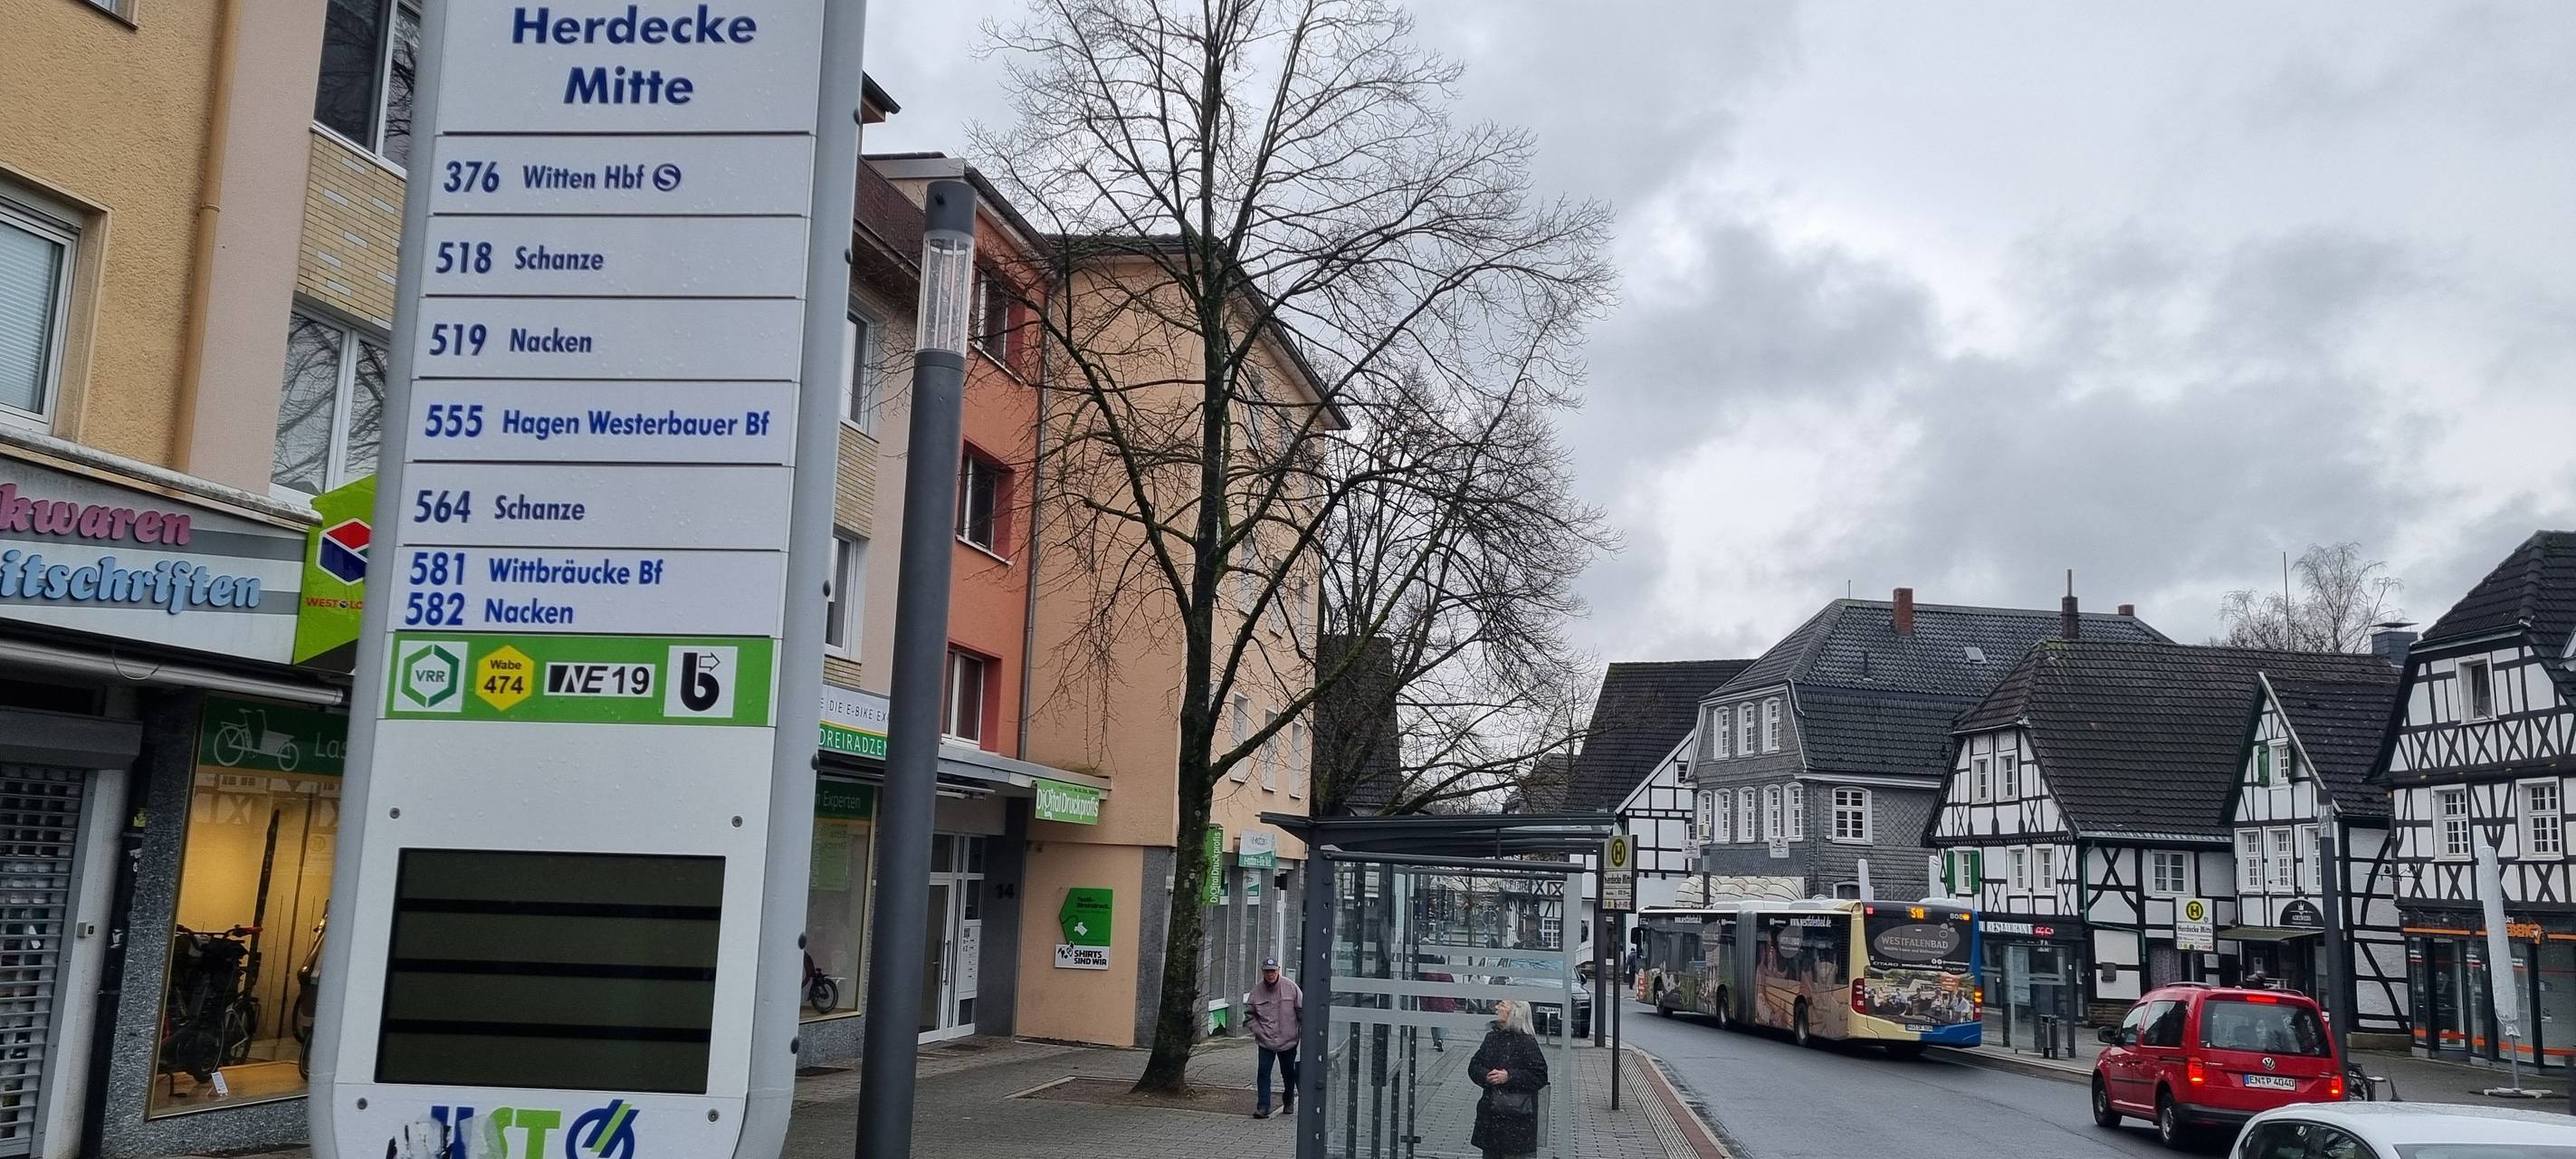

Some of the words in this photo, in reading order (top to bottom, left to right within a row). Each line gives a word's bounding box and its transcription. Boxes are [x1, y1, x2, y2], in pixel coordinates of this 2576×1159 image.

[512, 5, 757, 44] Herdecke
[563, 66, 693, 104] Mitte
[444, 161, 501, 193] 376
[522, 165, 596, 189] Witten
[604, 164, 644, 189] Hbf
[435, 242, 492, 273] 518
[515, 244, 605, 271] Schanze
[429, 323, 487, 356] 519
[510, 328, 592, 352] Nacken
[425, 405, 483, 437] 555
[502, 409, 579, 440] Hagen
[587, 410, 738, 436] Westerbauer
[745, 411, 769, 436] Bf
[0, 484, 192, 545] kwaren
[414, 490, 472, 523] 564
[494, 493, 586, 521] Schanze
[409, 552, 465, 586] 581
[489, 558, 630, 585] Wittbräucke
[639, 560, 663, 585] Bf
[0, 550, 262, 615] itschriften
[305, 597, 339, 608] WEST
[405, 592, 464, 626] 582
[484, 599, 573, 624] Nacken
[490, 659, 521, 670] Wabe
[415, 670, 445, 683] VRR
[483, 675, 524, 694] 474
[829, 700, 843, 713] DIE
[846, 704, 873, 720] E-BIKE
[823, 790, 861, 811] Experten
[1911, 907, 1924, 919] 518
[1987, 922, 2034, 934] RESTAURANT
[1882, 936, 1949, 950] WESTFALENBAD
[1074, 950, 1102, 958] SHIRTS
[1092, 958, 1107, 966] WIR
[2248, 1076, 2261, 1085] EN
[2274, 1078, 2295, 1087] 4040
